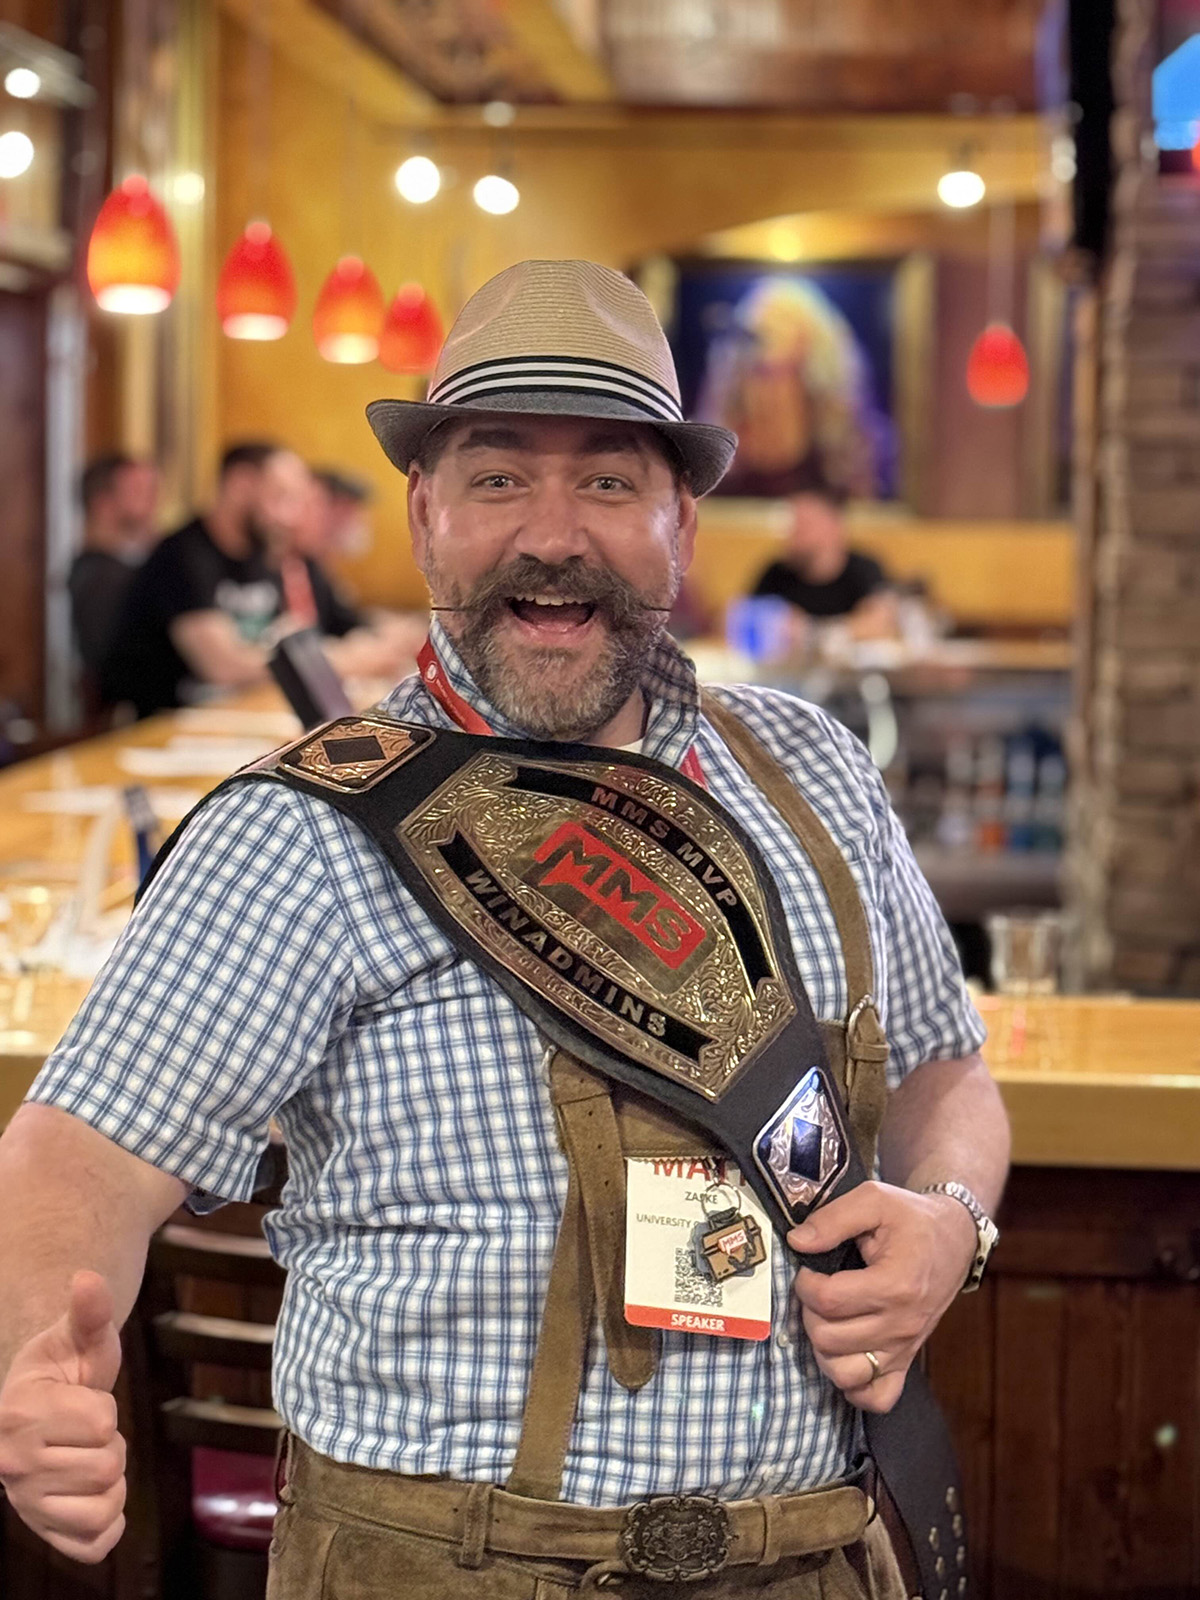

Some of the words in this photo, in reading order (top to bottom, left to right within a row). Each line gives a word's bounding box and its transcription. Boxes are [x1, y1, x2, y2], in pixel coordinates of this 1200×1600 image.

[592, 787, 671, 839] MMS
[677, 842, 739, 908] MVP
[536, 832, 692, 952] MMS
[465, 868, 667, 1038] WINADMINS
[685, 1191, 718, 1205] ZAKE
[636, 1213, 692, 1228] UNIVERSITY
[722, 1232, 744, 1247] MMS
[670, 1313, 725, 1332] SPEAKER
